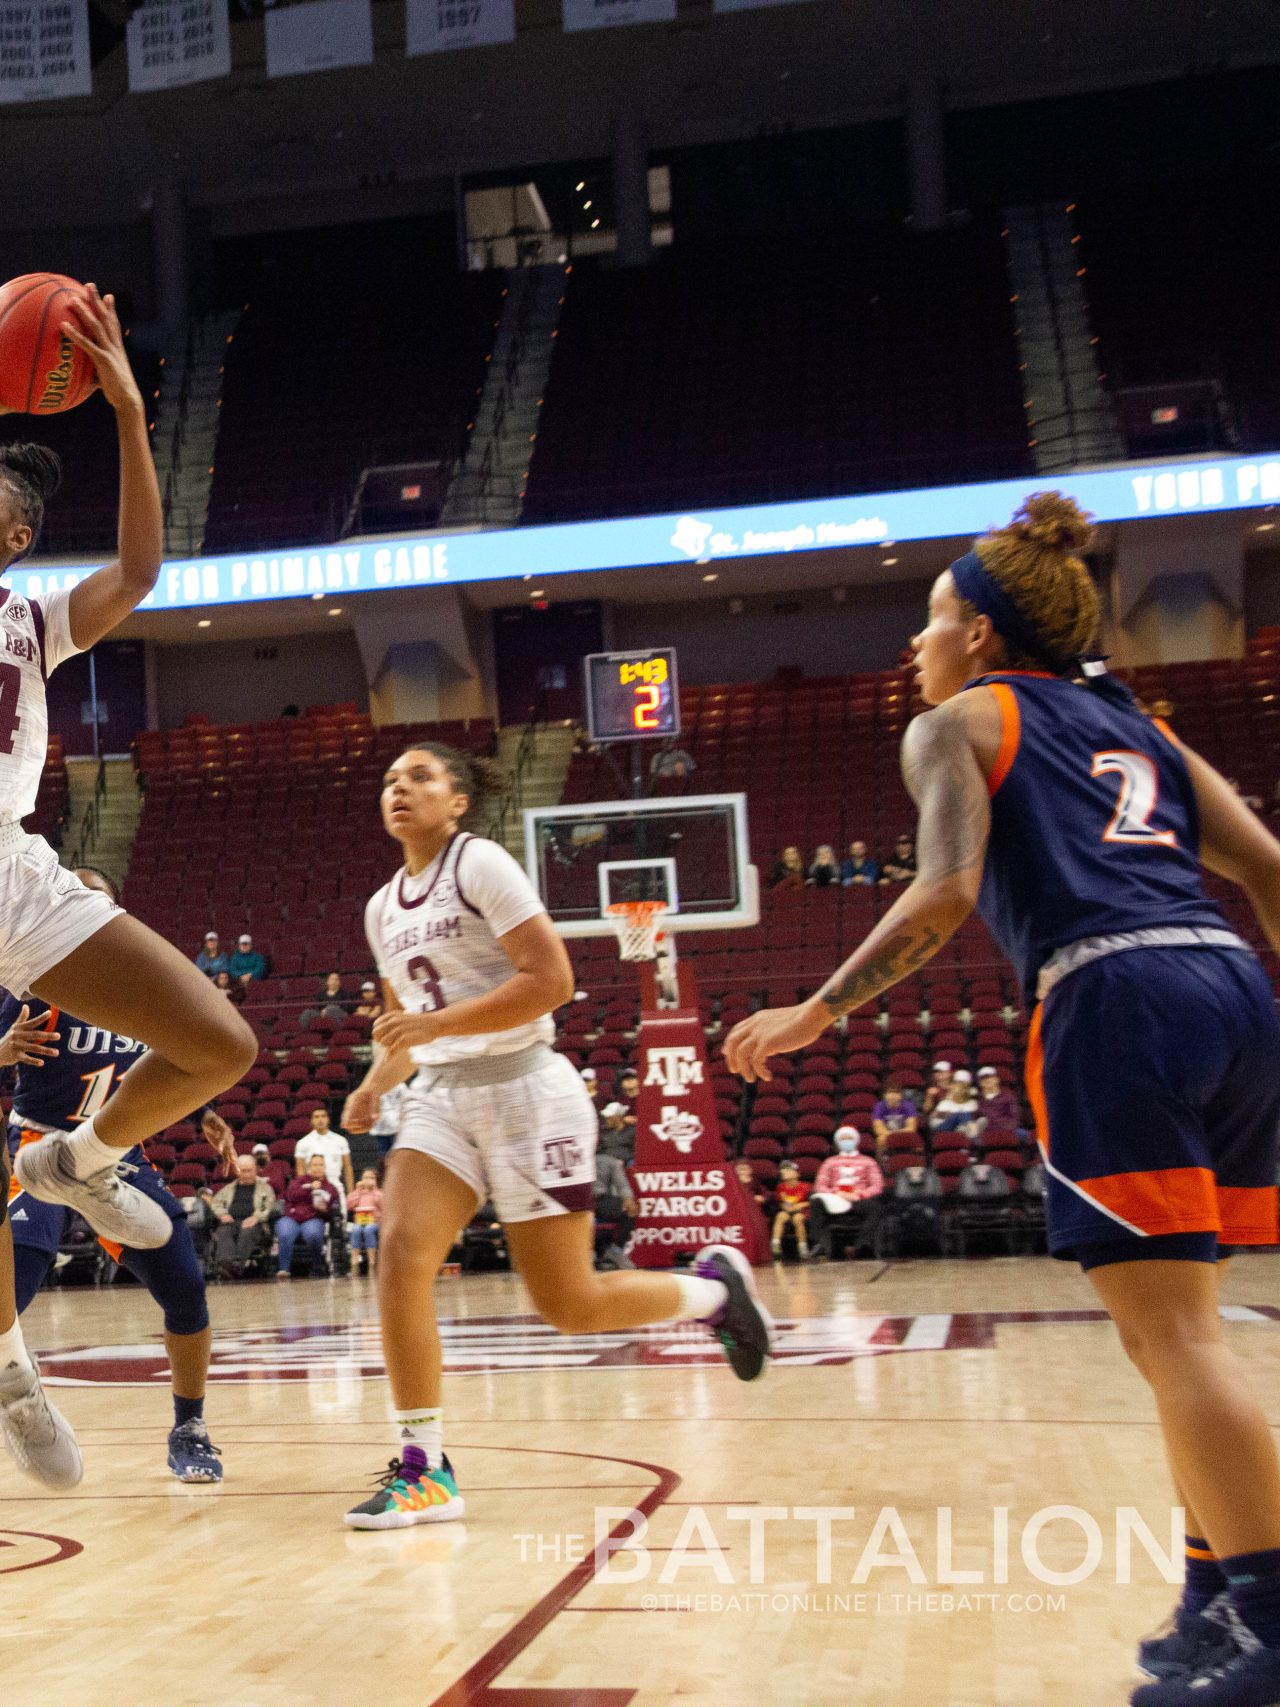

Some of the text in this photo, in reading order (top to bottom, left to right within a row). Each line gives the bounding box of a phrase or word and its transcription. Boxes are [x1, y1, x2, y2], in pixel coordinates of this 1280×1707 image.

[167, 543, 450, 603] FOR PRIMARY CARE
[634, 685, 660, 728] 2
[1091, 749, 1180, 849] 2
[407, 955, 446, 1013] 3
[634, 1170, 726, 1192] WELLS
[637, 1195, 728, 1218] FARGO
